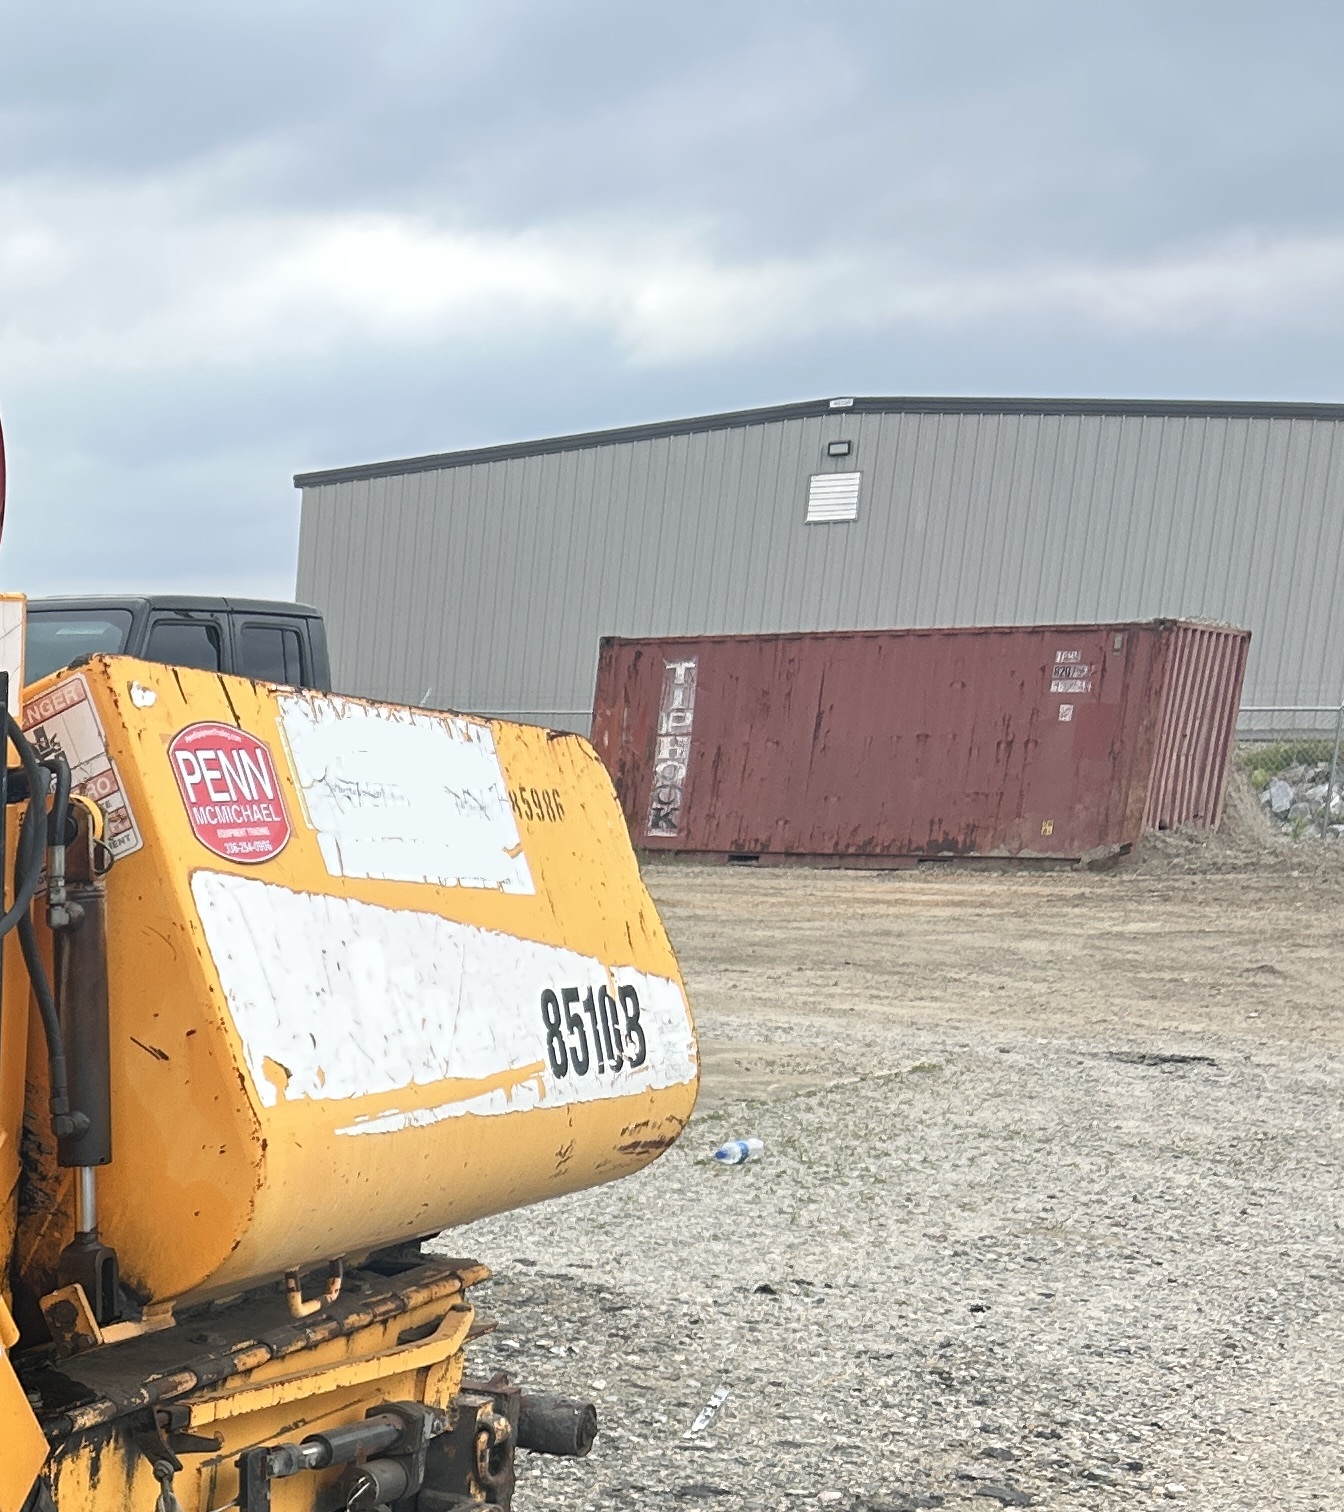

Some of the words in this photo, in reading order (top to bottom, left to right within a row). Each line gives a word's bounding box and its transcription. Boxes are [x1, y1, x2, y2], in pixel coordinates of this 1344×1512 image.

[24, 687, 79, 725] NGER
[175, 748, 274, 803] PENN
[193, 803, 282, 826] MCMICHAEL
